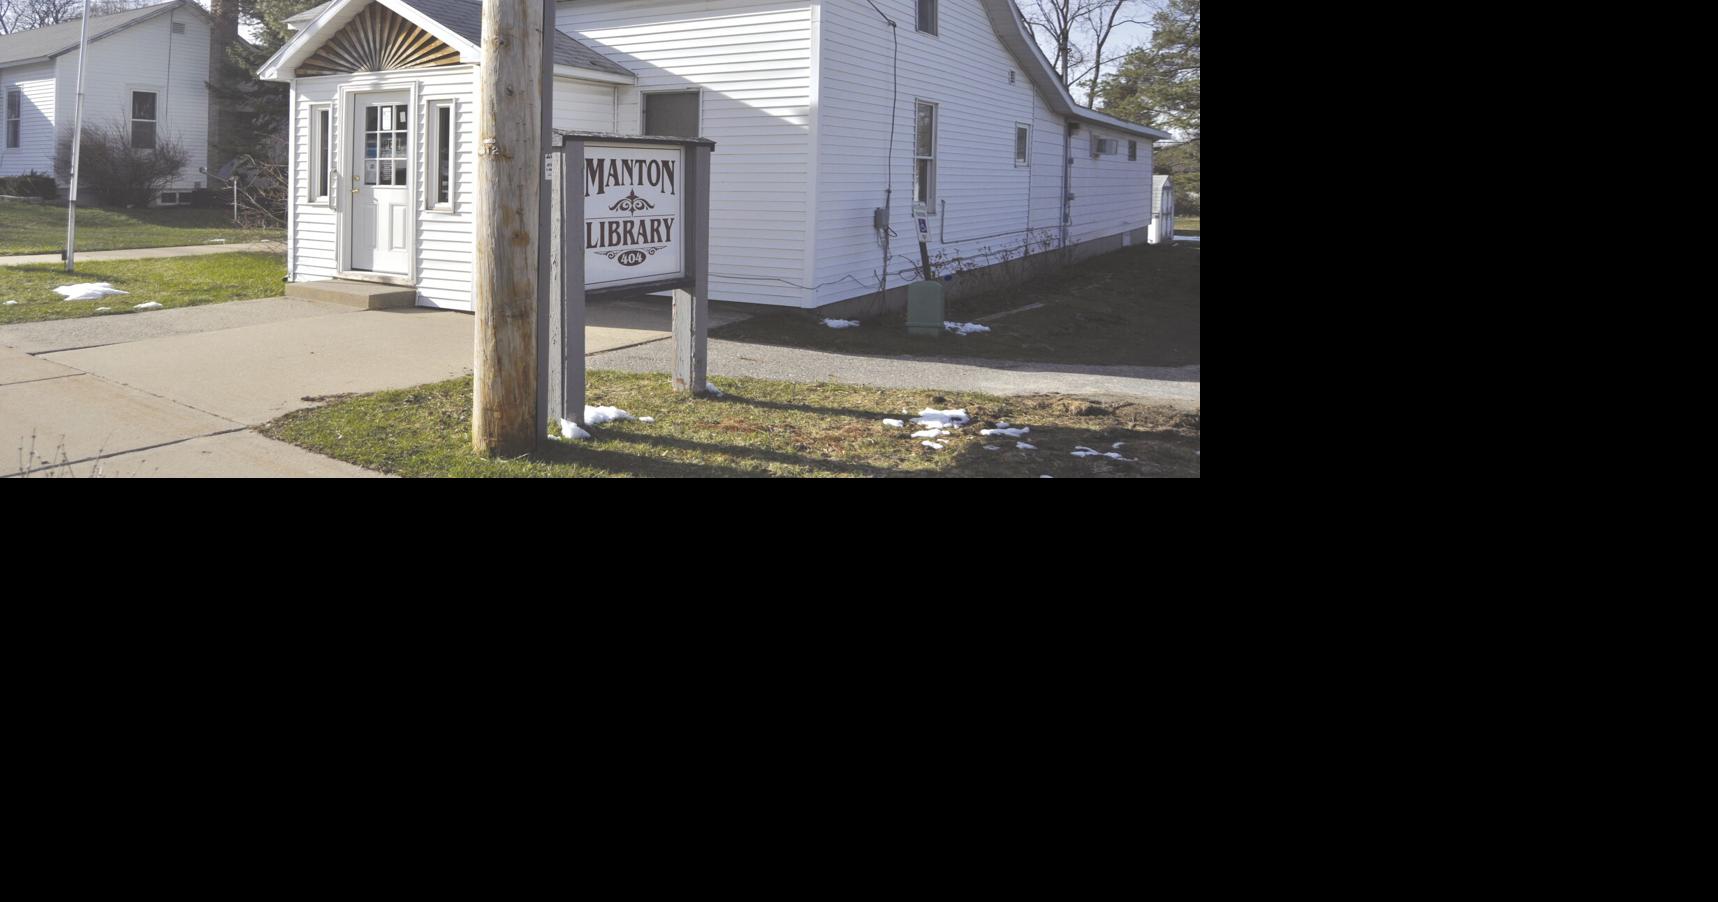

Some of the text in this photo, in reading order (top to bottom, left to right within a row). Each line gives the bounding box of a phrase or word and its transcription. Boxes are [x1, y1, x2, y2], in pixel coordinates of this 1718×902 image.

[585, 158, 675, 197] MANTON
[586, 218, 674, 249] LIBRARY
[620, 252, 643, 264] 404
